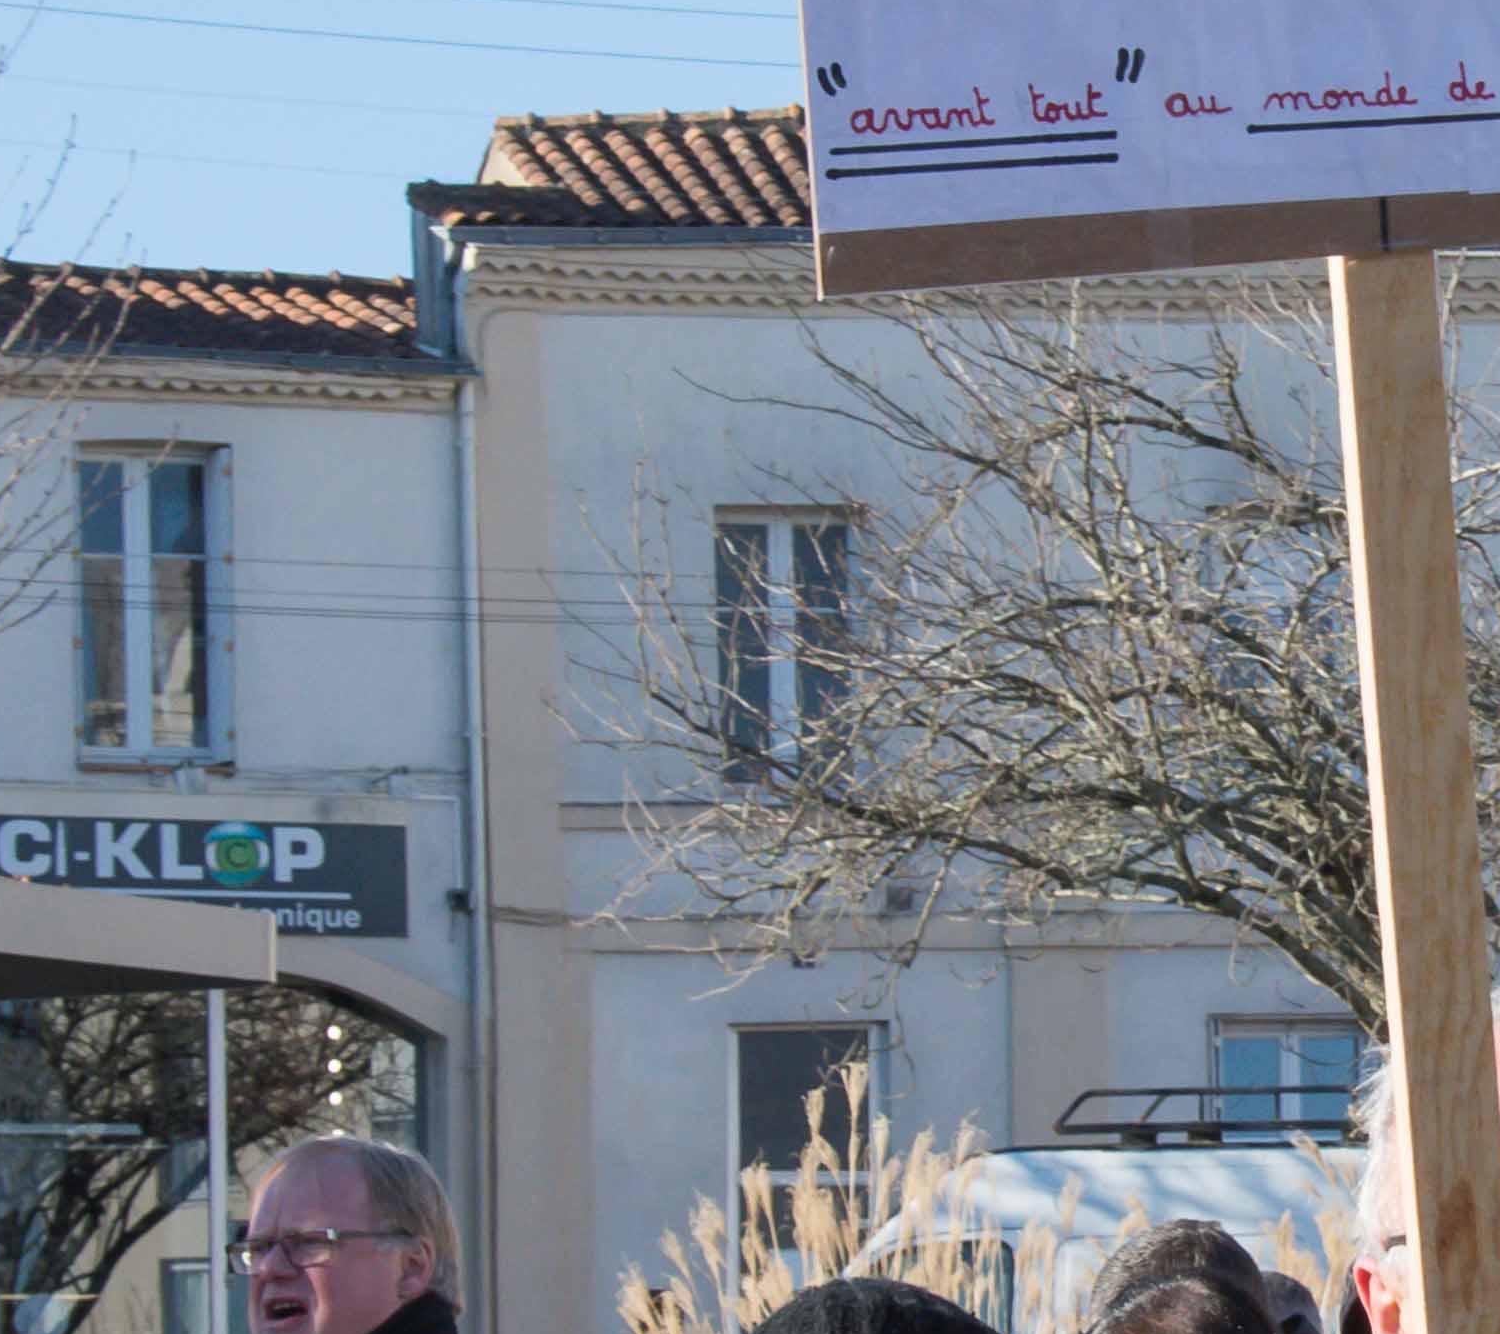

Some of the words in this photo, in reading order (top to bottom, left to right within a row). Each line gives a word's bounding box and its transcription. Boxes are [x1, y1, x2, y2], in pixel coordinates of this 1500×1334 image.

[816, 61, 997, 135] "avant
[1027, 46, 1147, 124] tout"
[1164, 91, 1234, 117] au
[1262, 71, 1419, 112] monde
[1448, 58, 1498, 103] de
